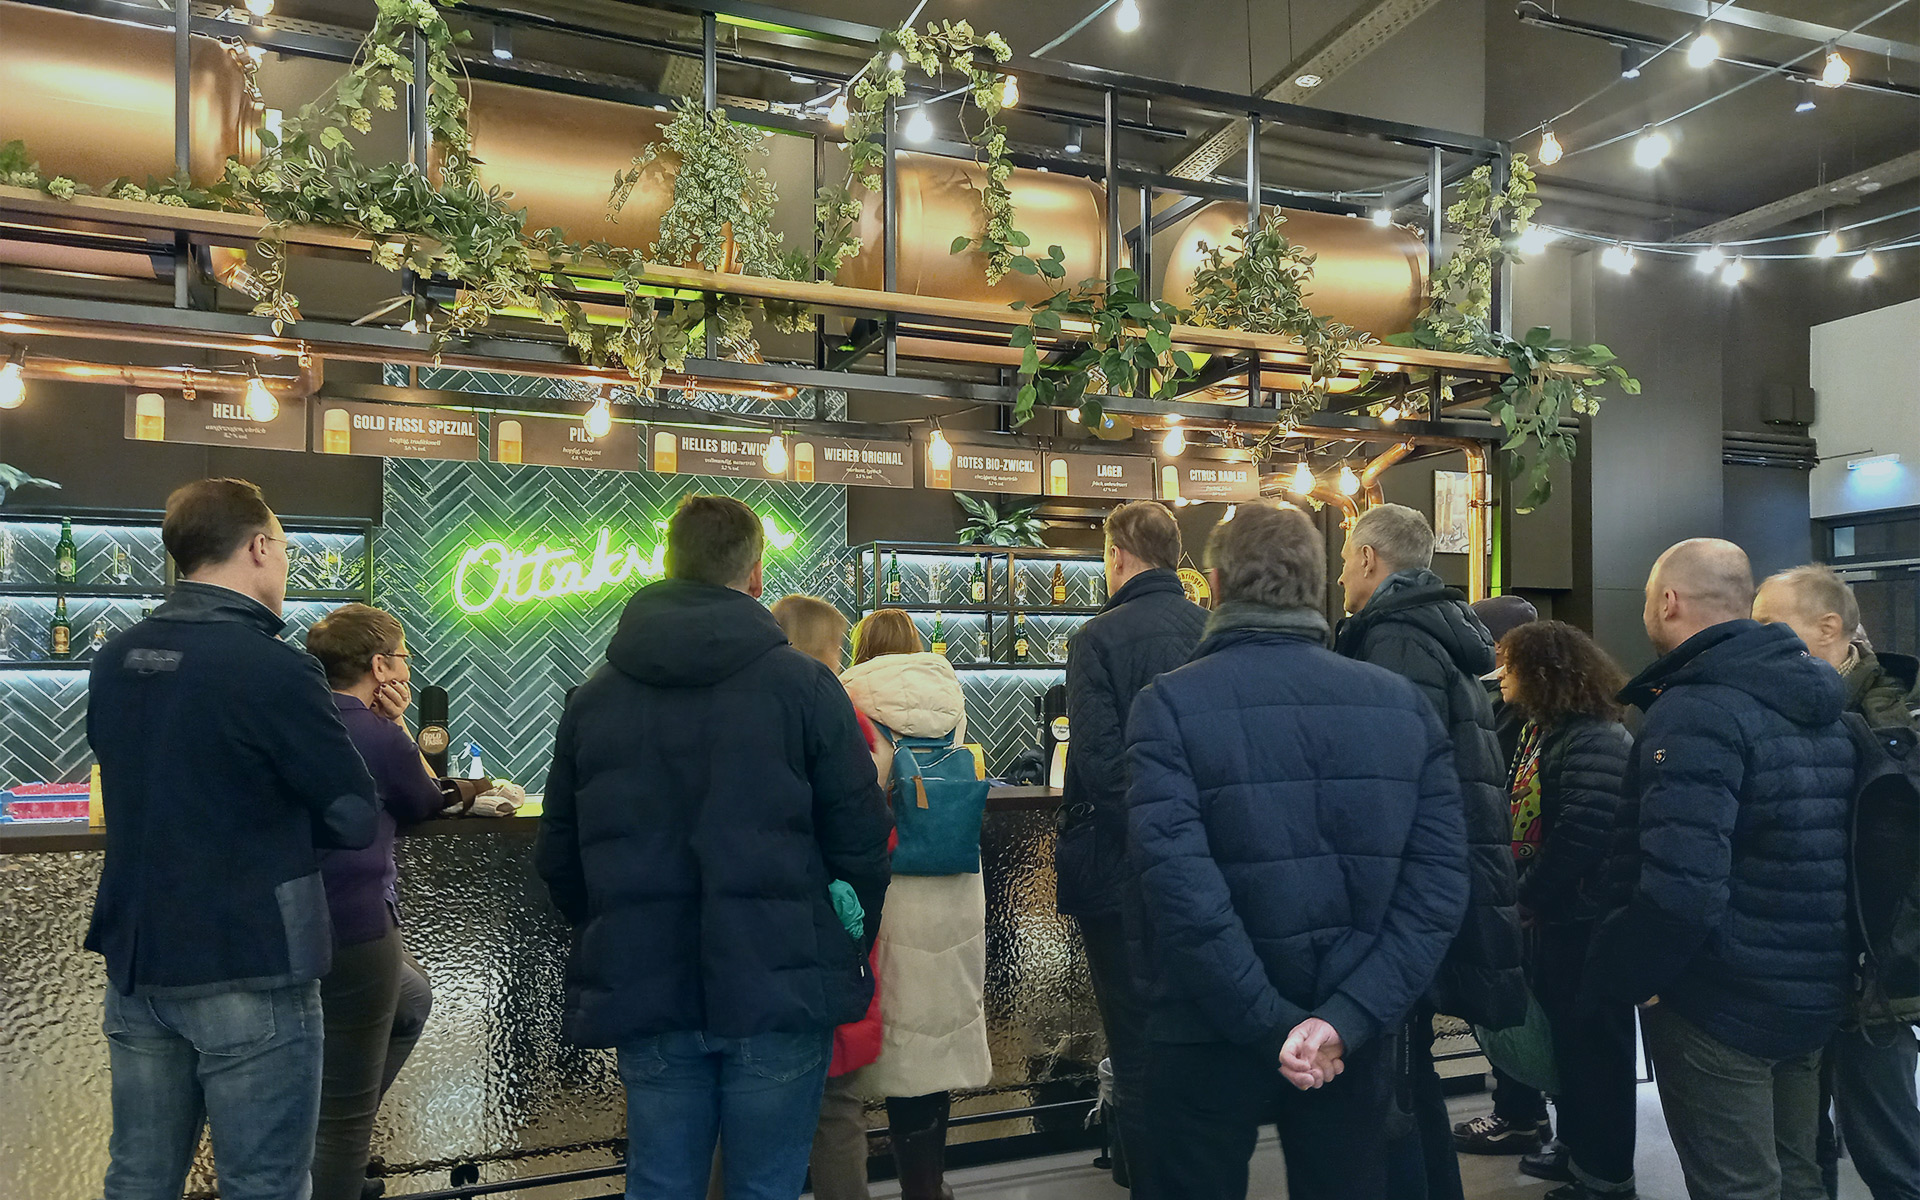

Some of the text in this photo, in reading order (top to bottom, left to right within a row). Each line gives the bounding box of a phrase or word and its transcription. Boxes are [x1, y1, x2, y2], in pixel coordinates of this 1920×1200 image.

[213, 402, 252, 420] HELL
[353, 414, 475, 436] GOLD FASSL SPEZIAL
[581, 448, 602, 456] elegant
[681, 436, 768, 457] HELLES BIO-ZWIC
[824, 447, 904, 466] WIENER ORIGINAL
[957, 455, 1035, 473] ROTES BIO-ZWICKL
[1097, 464, 1123, 478] LAGER
[1189, 469, 1247, 483] CITRUS RADLER
[422, 732, 441, 741] GOLD
